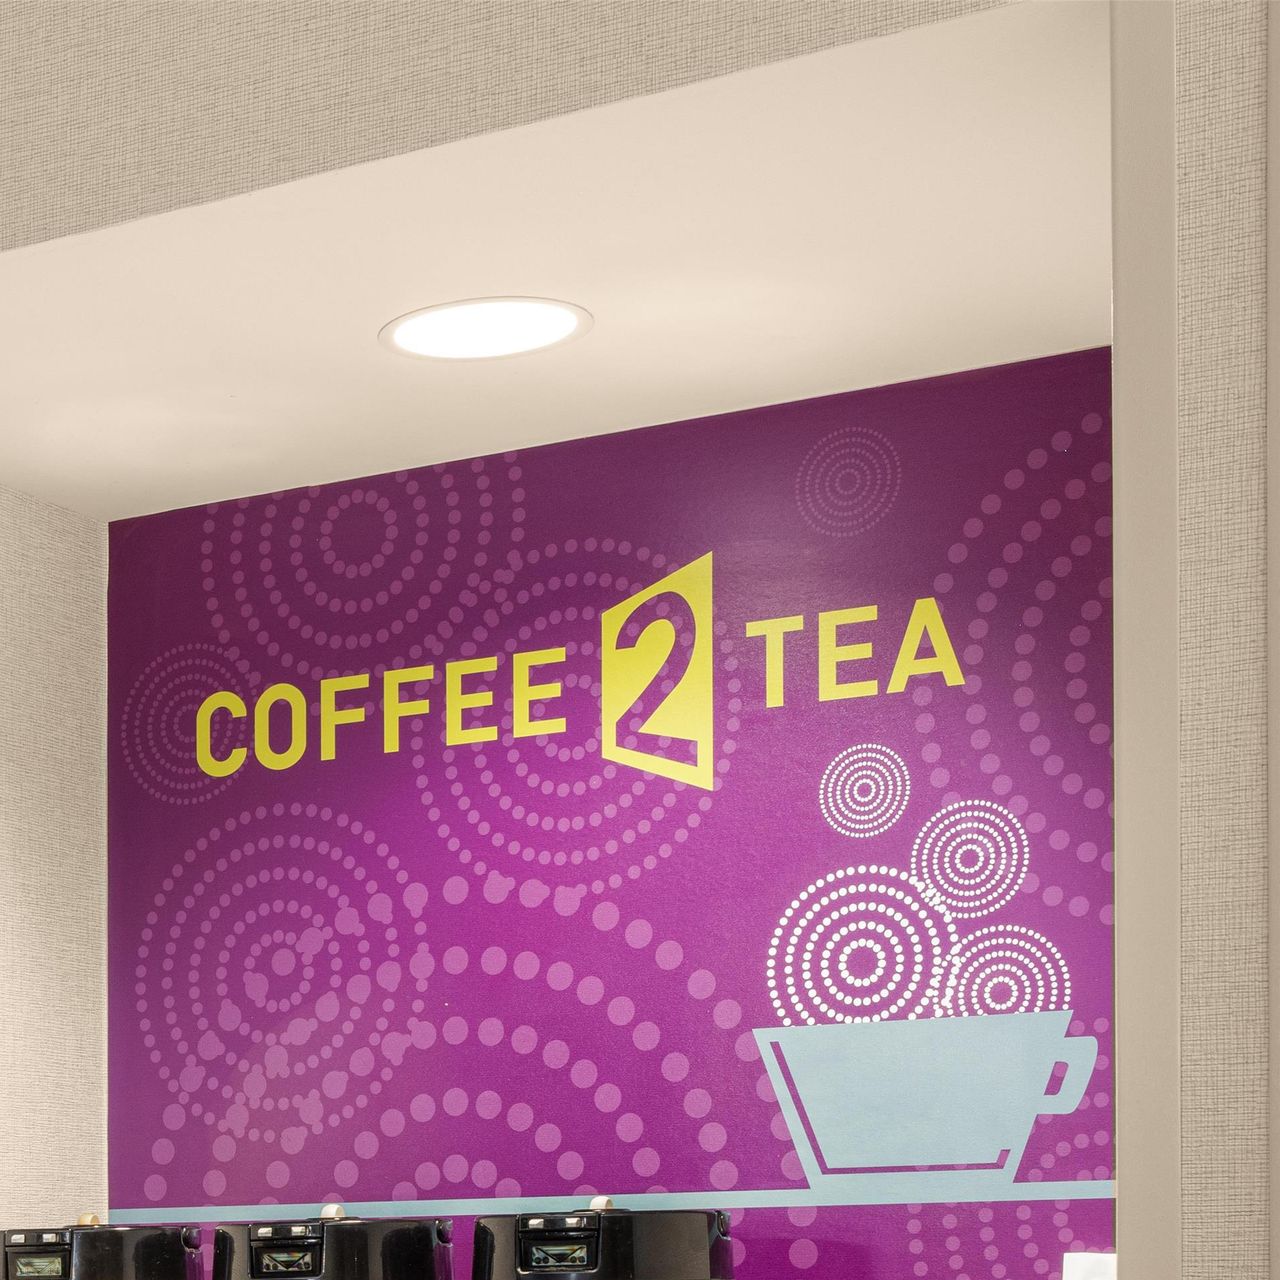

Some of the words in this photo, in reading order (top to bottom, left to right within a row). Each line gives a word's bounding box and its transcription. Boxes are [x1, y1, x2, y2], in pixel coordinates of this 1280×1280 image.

[196, 646, 566, 778] COFFEE
[616, 590, 699, 768] 2
[746, 596, 965, 708] TEA
